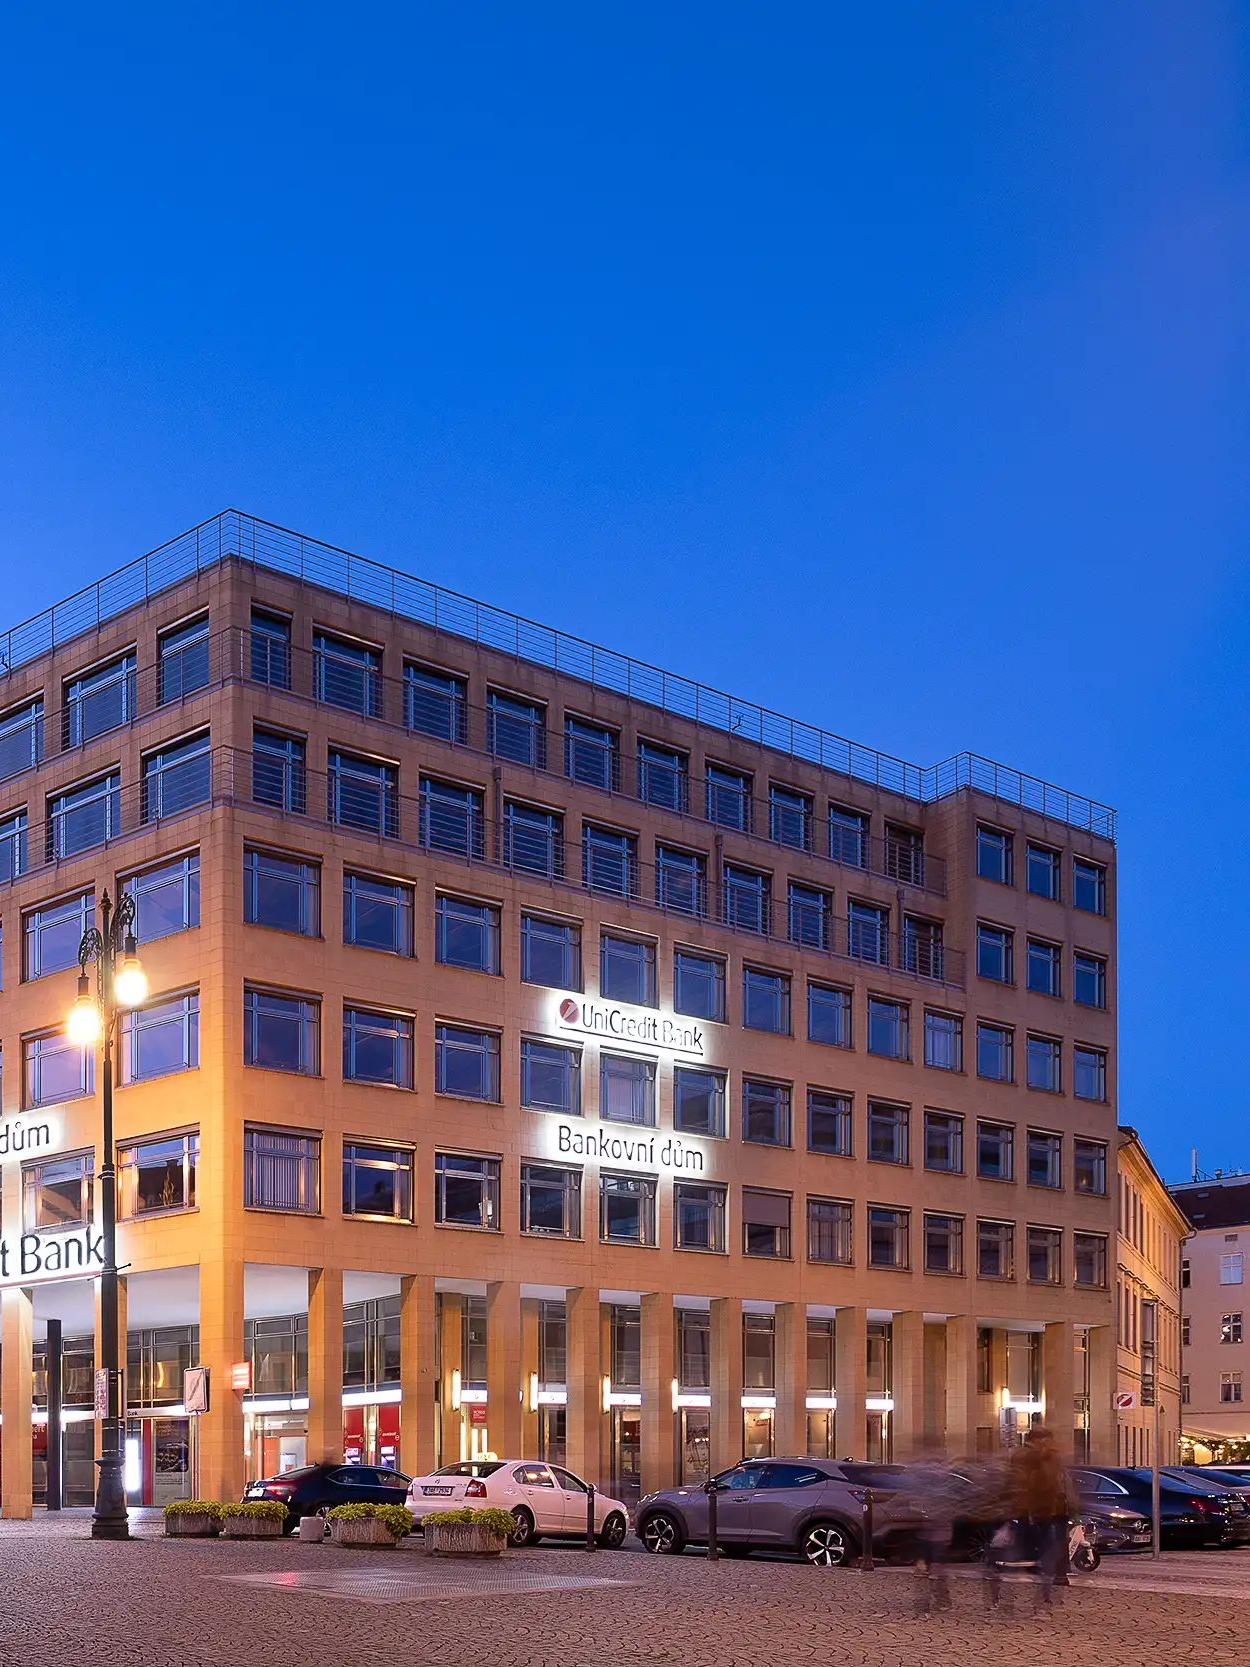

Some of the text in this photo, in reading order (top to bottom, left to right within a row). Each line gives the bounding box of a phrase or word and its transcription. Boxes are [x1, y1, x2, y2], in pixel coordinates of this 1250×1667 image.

[582, 1003, 704, 1050] UniCredit Bank
[558, 1125, 704, 1171] Bankovní dům
[20, 1226, 105, 1275] Bank
